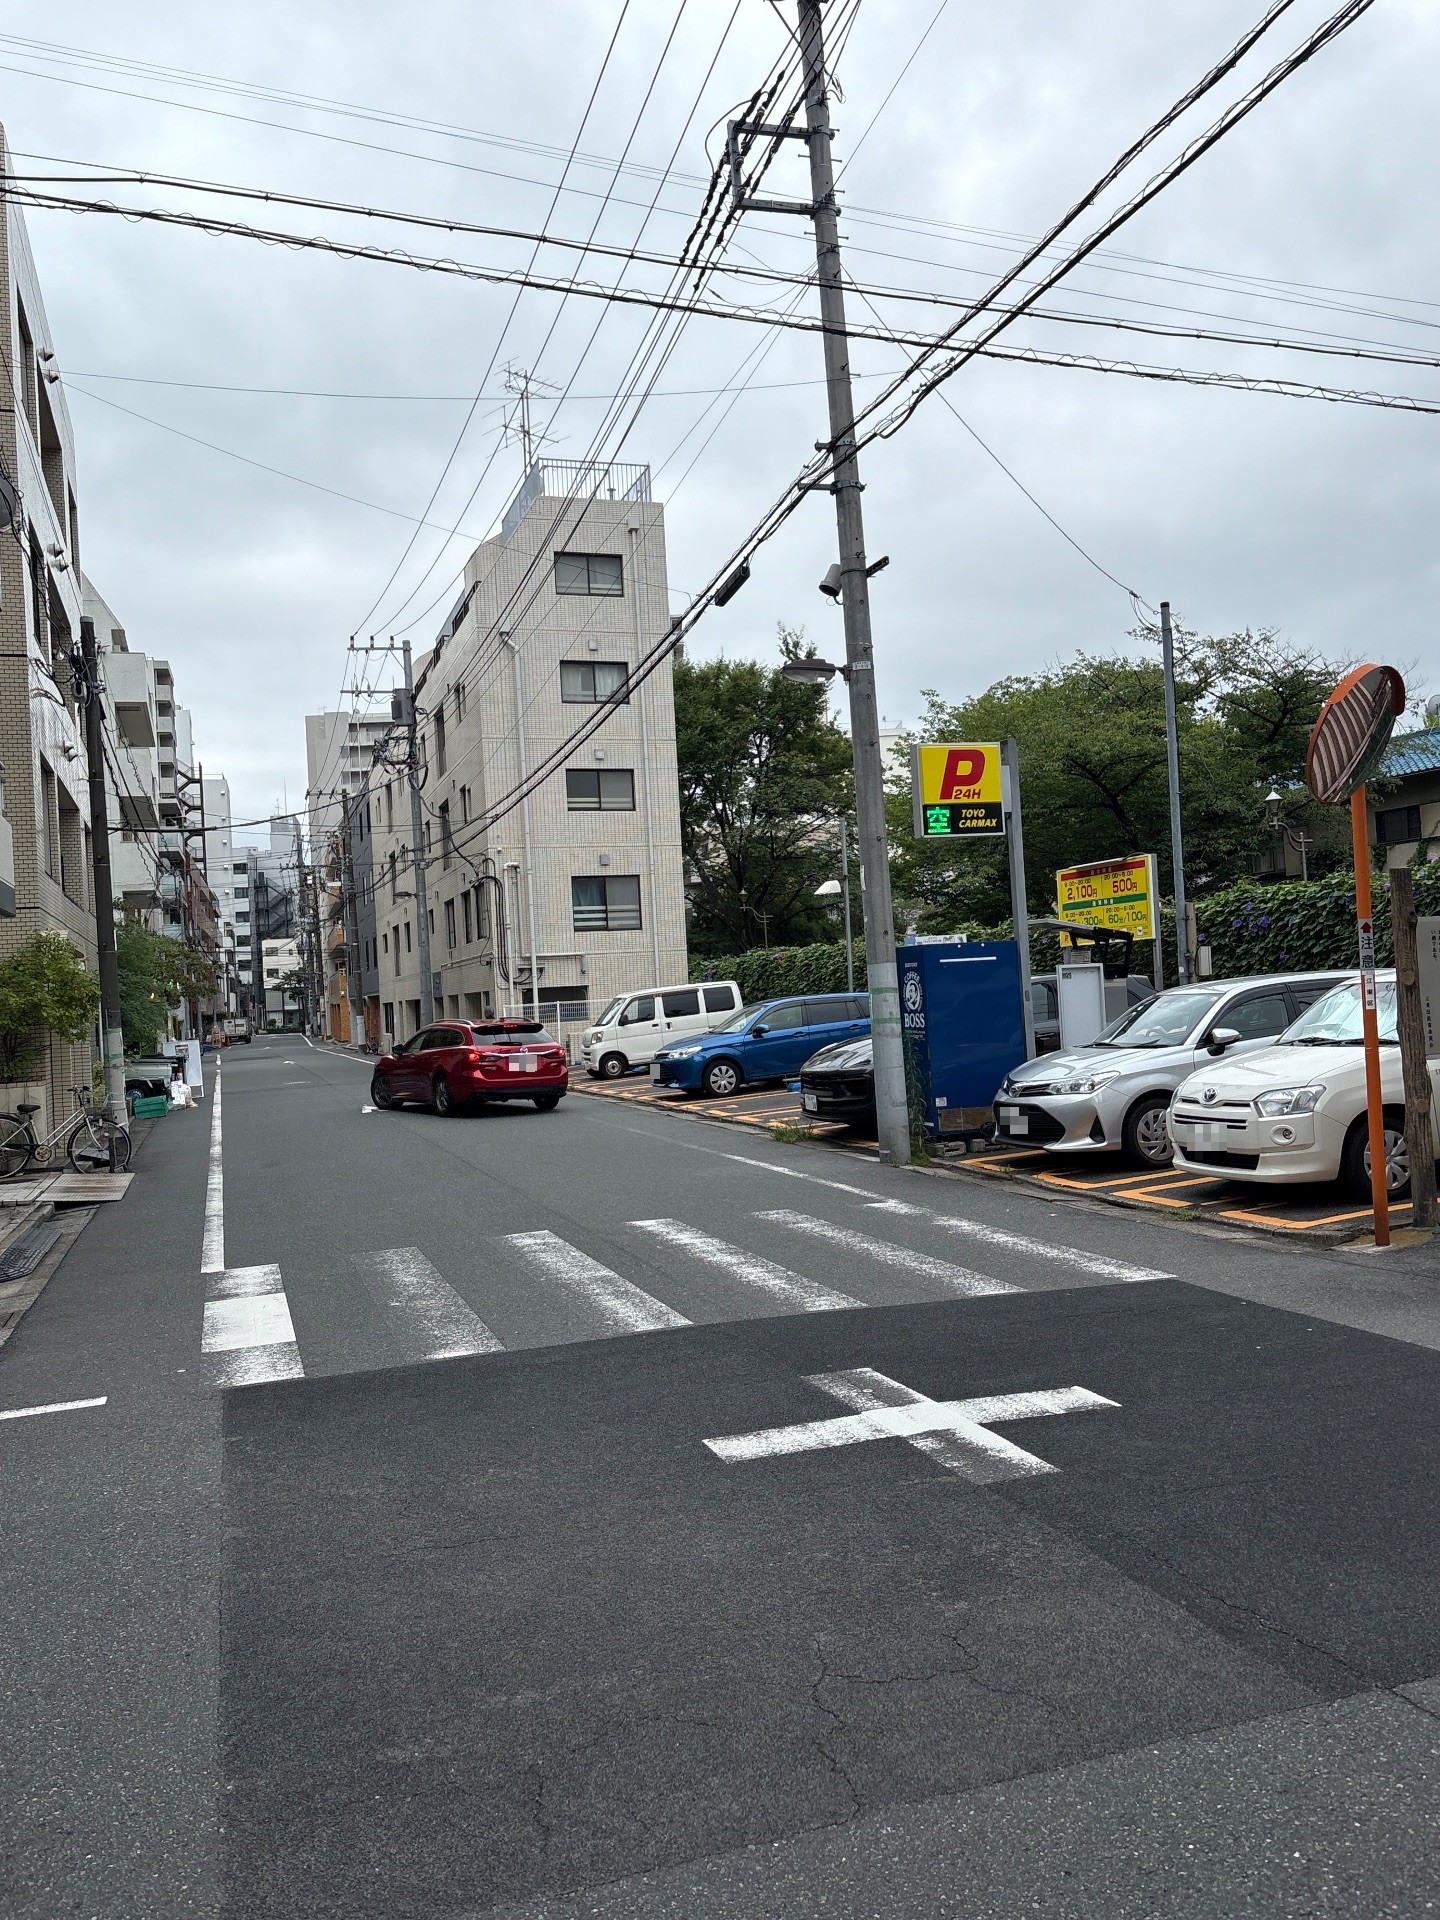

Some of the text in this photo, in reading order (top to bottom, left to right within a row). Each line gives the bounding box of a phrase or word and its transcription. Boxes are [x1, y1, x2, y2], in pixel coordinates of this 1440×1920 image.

[939, 749, 986, 800] P
[953, 788, 982, 800] 24H
[926, 806, 951, 834] 空
[961, 808, 986, 818] TOYO
[958, 818, 998, 828] CARMAX
[1066, 884, 1098, 901] 2,100円
[1112, 877, 1138, 894] 500円
[1361, 936, 1374, 968] 注意
[904, 971, 920, 984] COFFEE
[903, 1012, 926, 1028] BOSS
